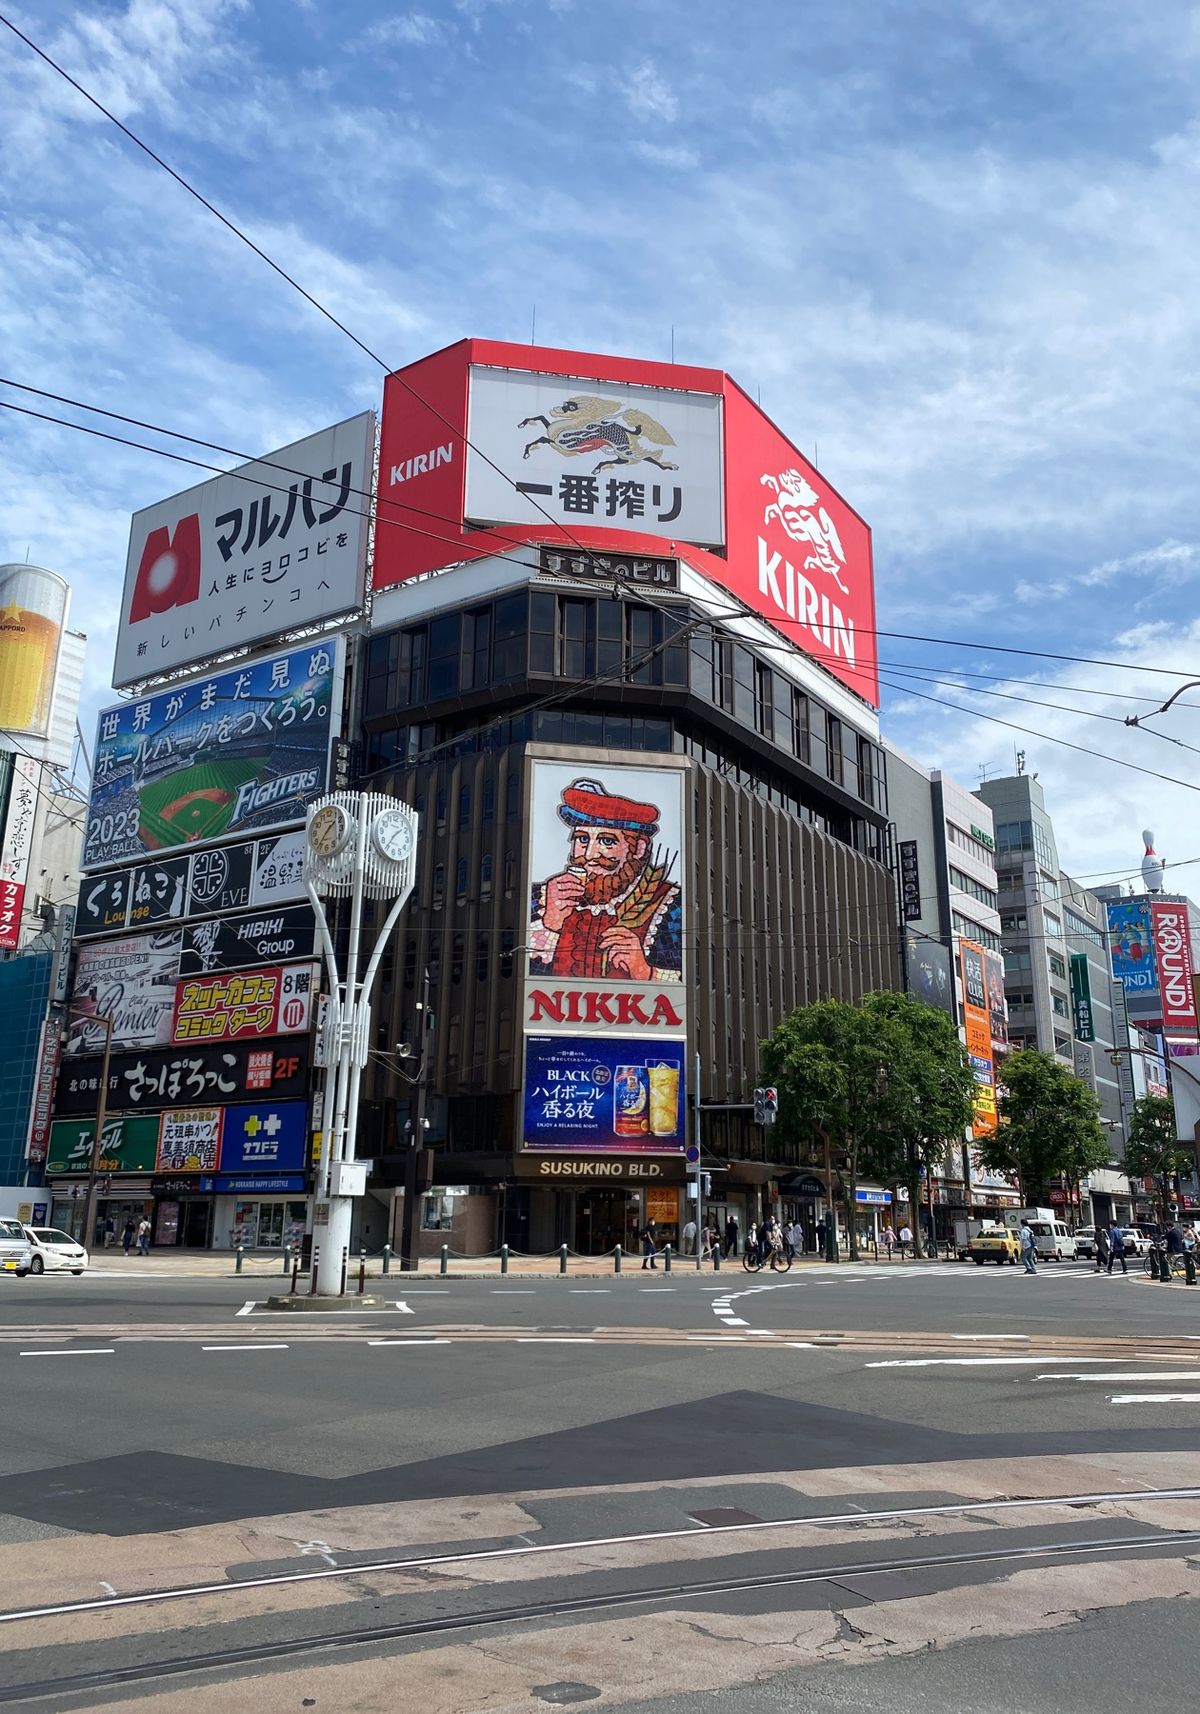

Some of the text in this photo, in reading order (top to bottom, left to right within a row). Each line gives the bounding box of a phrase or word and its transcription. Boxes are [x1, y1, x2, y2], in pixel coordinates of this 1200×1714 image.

[390, 442, 453, 486] KIRIN
[214, 462, 352, 563] マルハン
[515, 473, 683, 523] 一番搾り
[208, 532, 348, 597] 人生にヨロコビを
[546, 553, 671, 583] すすきのビル
[136, 579, 331, 656] 新しいパチンコへ
[757, 536, 856, 670] KIRIN
[101, 649, 330, 743] 世界がまだ見ぬ
[97, 690, 328, 777] ボールパークをつくろう。
[225, 767, 322, 832] FIGHTERS
[88, 807, 141, 847] 2023
[85, 840, 136, 861] PLAY BALL
[260, 844, 272, 855] 2F
[221, 887, 248, 907] EVE
[104, 905, 150, 925] Lounge
[236, 918, 285, 940] HIBIKI
[257, 939, 294, 955] Group
[1156, 912, 1195, 1017] ROUND1
[180, 976, 276, 1012] ネットカフェ
[283, 972, 310, 994] 8階
[176, 1006, 275, 1040] コミック ダーツ
[528, 989, 683, 1026] NIKKA
[69, 1053, 237, 1101] 北の味行 さっぽろっこ
[275, 1057, 299, 1079] 2F
[547, 1069, 590, 1083] BLACK
[531, 1084, 604, 1100] ハイボール
[541, 1100, 595, 1120] 香る夜
[164, 1123, 212, 1139] 元祖串かつ
[540, 1161, 665, 1177] SUSUKINO BLD.
